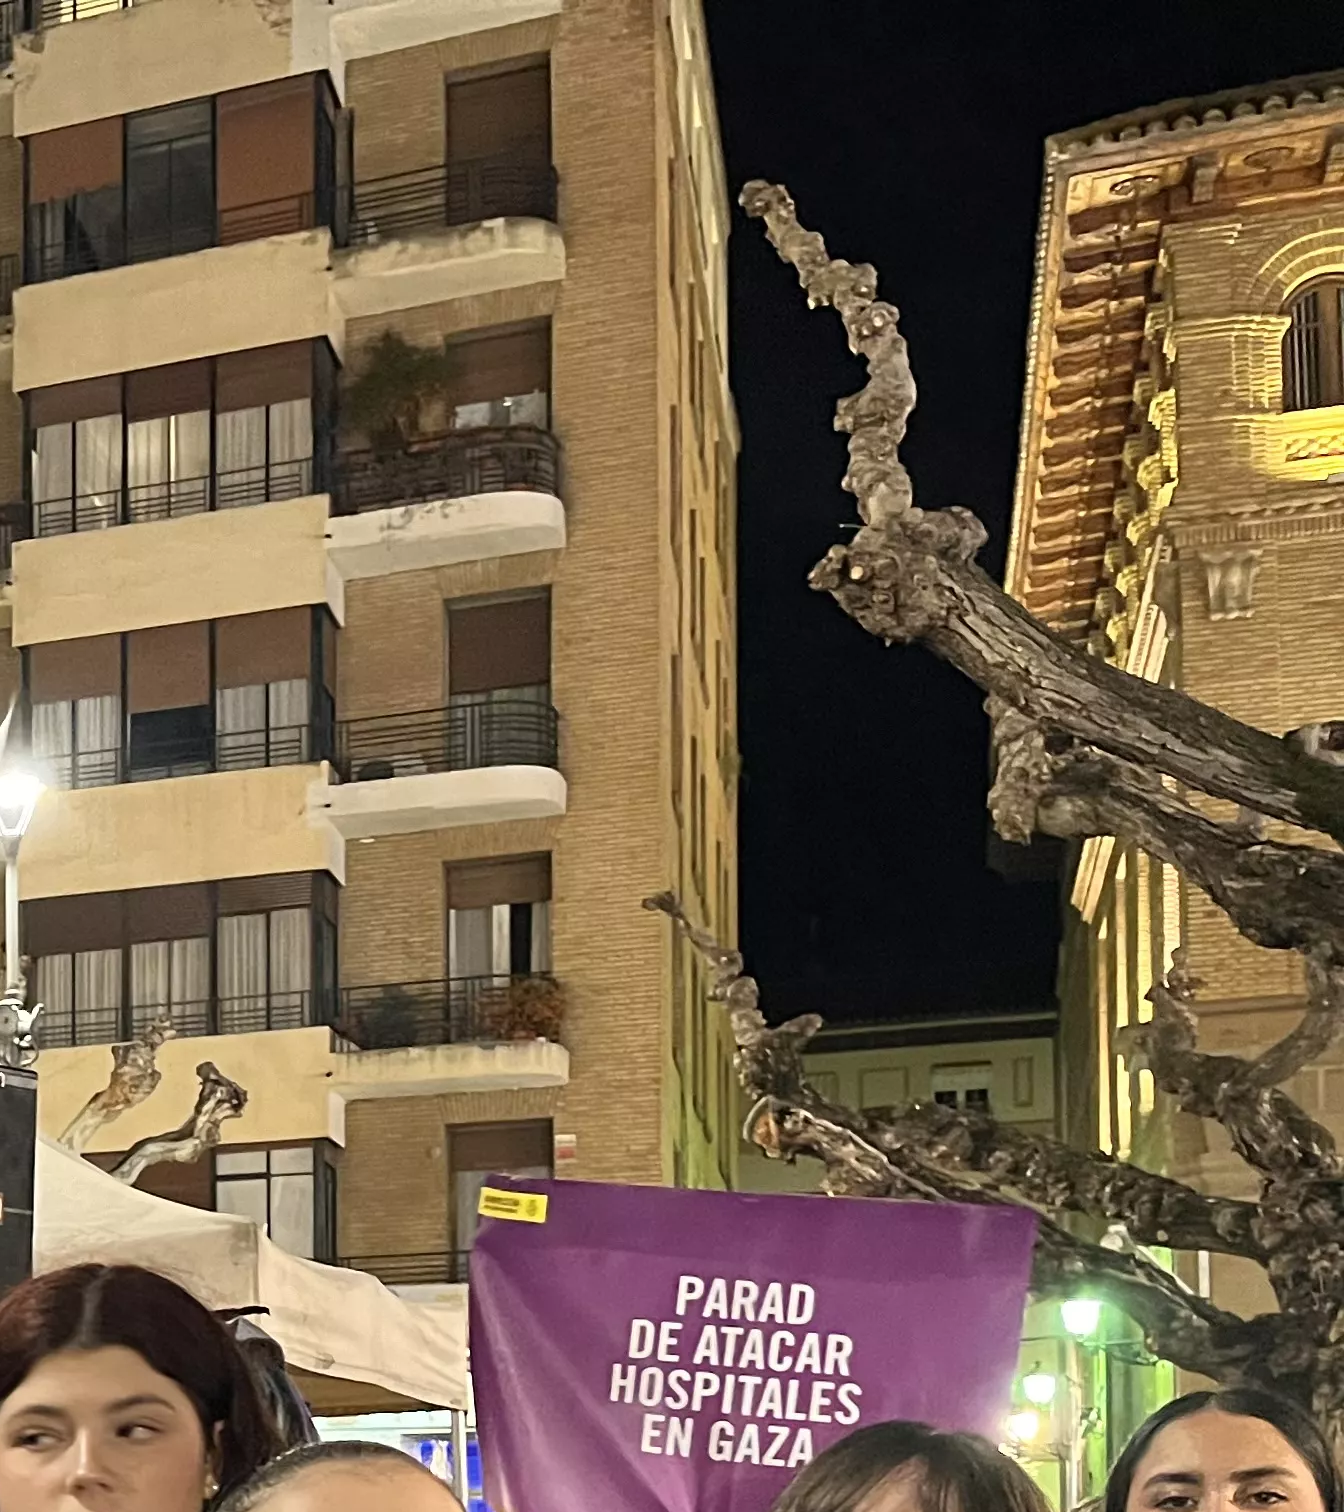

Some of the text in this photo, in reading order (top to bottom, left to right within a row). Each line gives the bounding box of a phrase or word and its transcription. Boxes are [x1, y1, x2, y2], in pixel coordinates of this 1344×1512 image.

[675, 1275, 816, 1326] PARAD
[628, 1318, 854, 1377] DE ATACAR
[609, 1363, 863, 1425] HOSPITALES
[640, 1413, 814, 1469] EN GAZA
